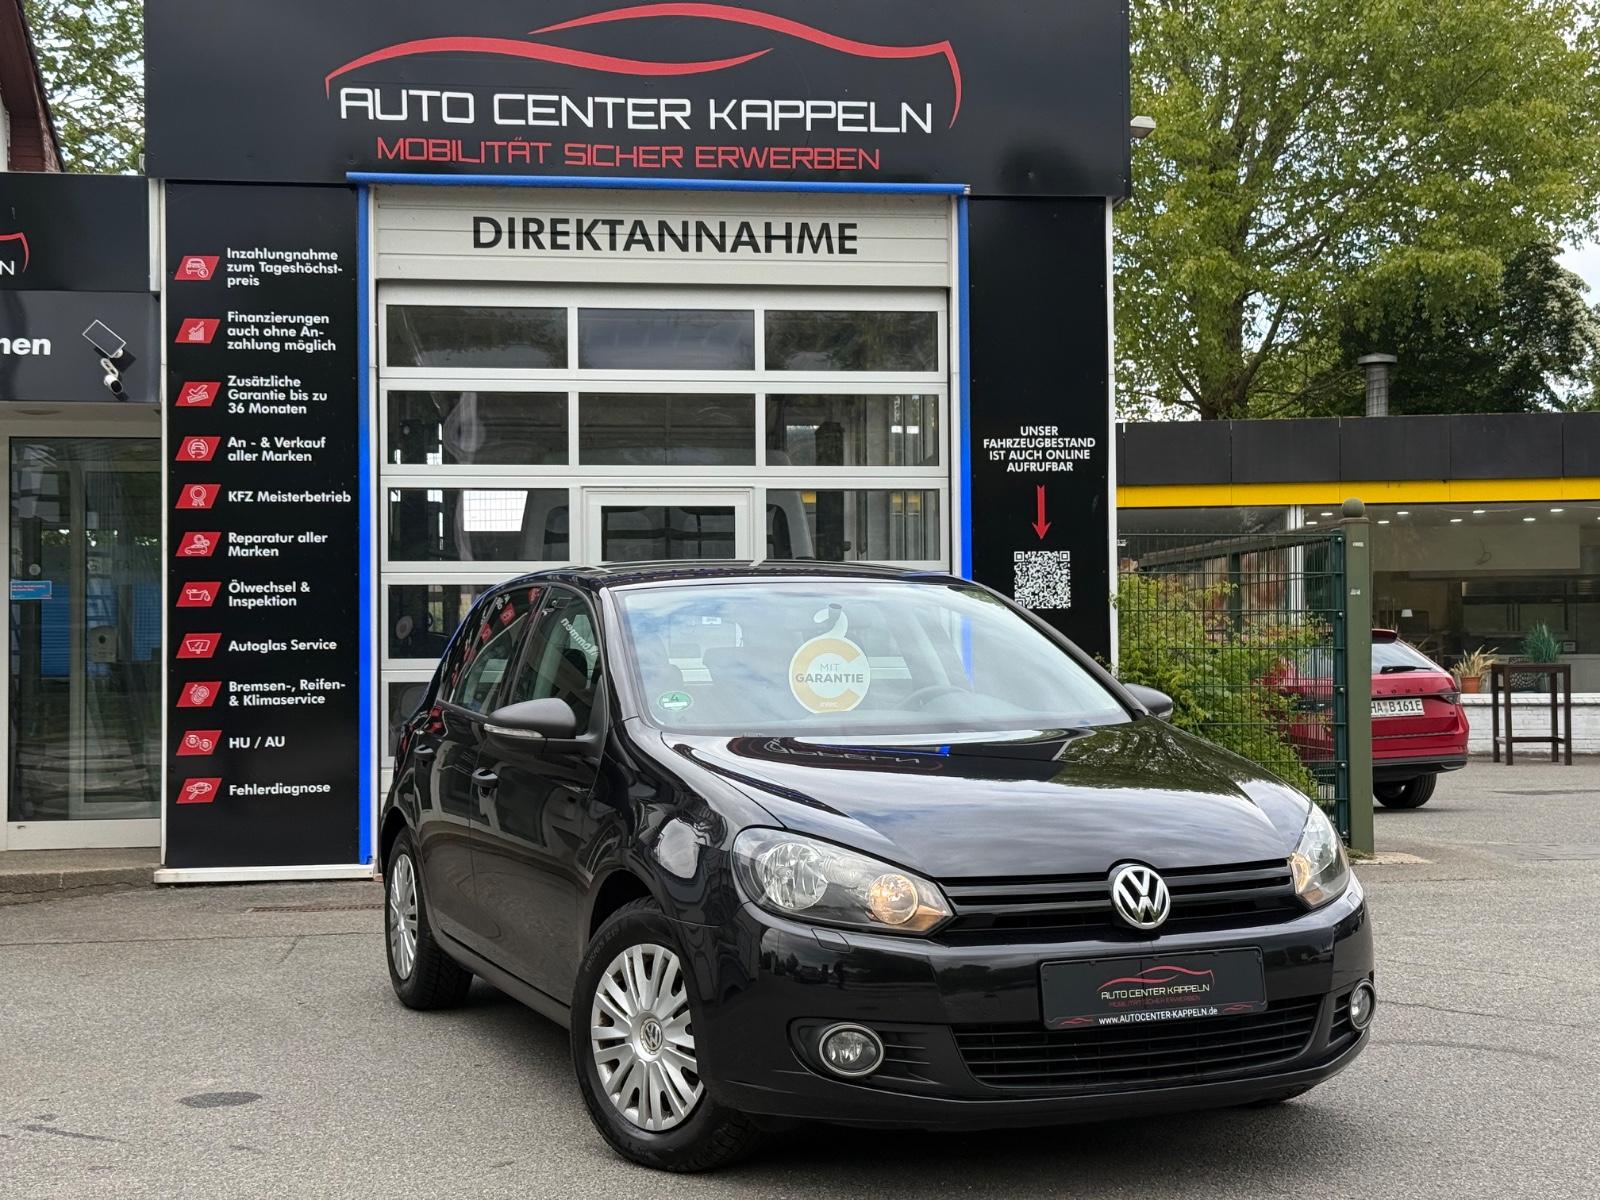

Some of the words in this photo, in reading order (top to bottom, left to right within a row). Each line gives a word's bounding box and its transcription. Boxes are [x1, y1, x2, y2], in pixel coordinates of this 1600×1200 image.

[340, 88, 474, 123] AUTO
[494, 94, 691, 129] CENTER
[710, 99, 931, 133] KAPPELN
[376, 137, 550, 164] MOBILITÄT
[564, 143, 683, 168] SICHER
[694, 145, 880, 170] ERWERBEN
[473, 216, 858, 255] DIREKTANNAHME
[227, 248, 338, 262] Inzahlungnahme
[227, 264, 254, 272] zum
[259, 262, 342, 275] Tageshöchst-
[227, 276, 260, 288] preis
[227, 311, 329, 326] Finanzierungen
[227, 325, 259, 337] auch
[263, 325, 296, 337] ohne
[300, 326, 324, 337] An-
[227, 340, 280, 352] zahlung
[285, 340, 336, 353] möglich
[228, 375, 301, 387] Zusätzliche
[228, 389, 286, 400] Garantie
[290, 389, 308, 400] bis
[228, 403, 244, 413] 36
[249, 403, 306, 414] Monaten
[1021, 426, 1058, 436] UNSER
[228, 437, 246, 447] An
[261, 437, 270, 447] &
[274, 437, 326, 448] Verkauf
[984, 438, 1095, 448] FAHRZEUGBESTAND
[228, 450, 258, 461] aller
[262, 450, 312, 461] Marken
[990, 451, 1005, 460] IST
[1009, 450, 1042, 460] AUCH
[1046, 450, 1090, 459] ONLINE
[1007, 462, 1073, 472] AUFRUFBAR
[229, 491, 253, 502] KFZ
[257, 491, 351, 502] Meisterbetrieb
[229, 532, 294, 545] Reparatur
[298, 532, 328, 543] aller
[228, 545, 278, 556] Marken
[229, 580, 296, 593] Ölwechsel
[301, 582, 310, 592] &
[229, 595, 296, 609] Inspektion
[229, 640, 287, 653] Autoglas
[291, 639, 337, 650] Service
[820, 663, 839, 672] MIT
[795, 673, 864, 683] GARANTIE
[229, 681, 295, 692] Bremsen-,
[300, 678, 345, 690] Reifen-
[229, 696, 238, 706] &
[244, 694, 325, 706] Klimaservice
[230, 737, 250, 748] HU
[265, 736, 285, 747] AU
[230, 783, 330, 796] Fehlerdiagnose
[1101, 988, 1127, 1000] AUTO
[1129, 987, 1165, 998] CENTER
[1167, 984, 1210, 995] KAPPELN
[1099, 1006, 1218, 1025] www.AUTOCENTER-KAPPELN.de
